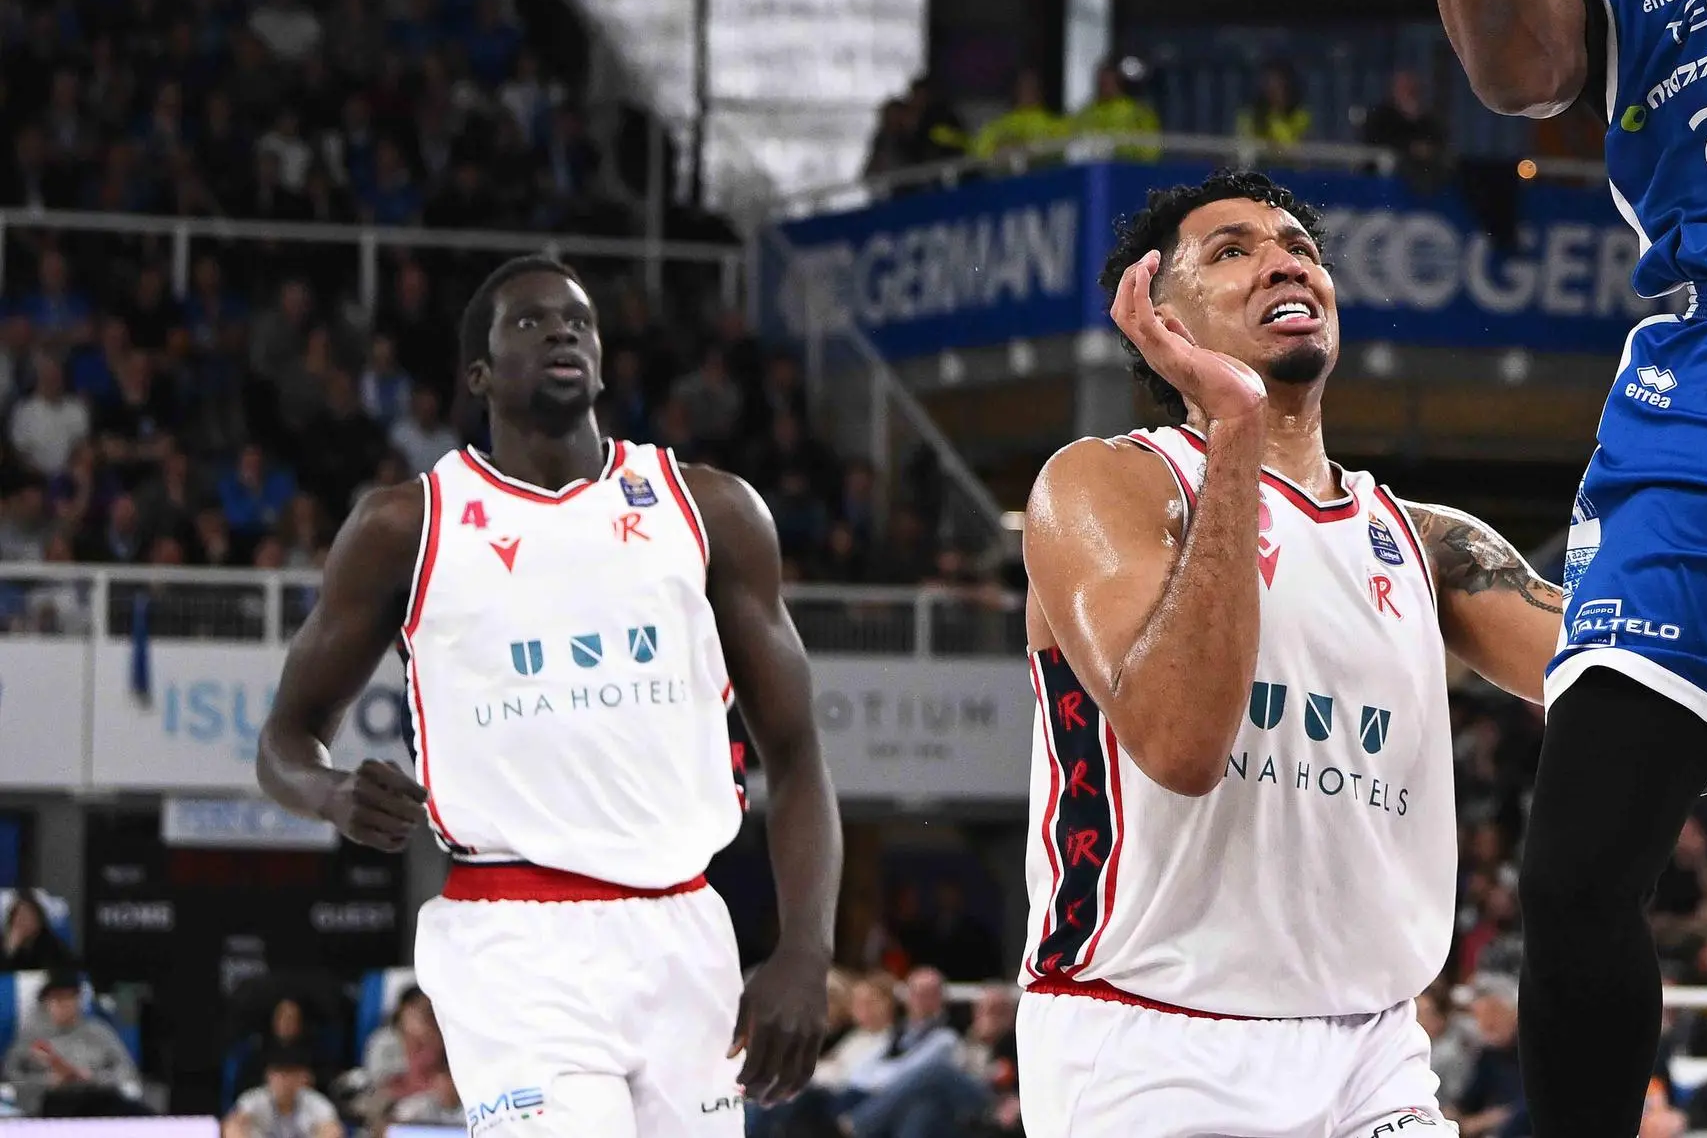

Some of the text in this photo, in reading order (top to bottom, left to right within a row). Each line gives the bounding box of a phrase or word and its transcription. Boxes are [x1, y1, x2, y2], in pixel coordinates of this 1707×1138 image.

[1625, 382, 1672, 409] errea
[460, 500, 489, 530] 4
[1370, 529, 1395, 545] LBA
[1582, 608, 1614, 618] GRUPPO
[475, 694, 554, 727] UNA
[1226, 751, 1409, 816] NA HOTELS
